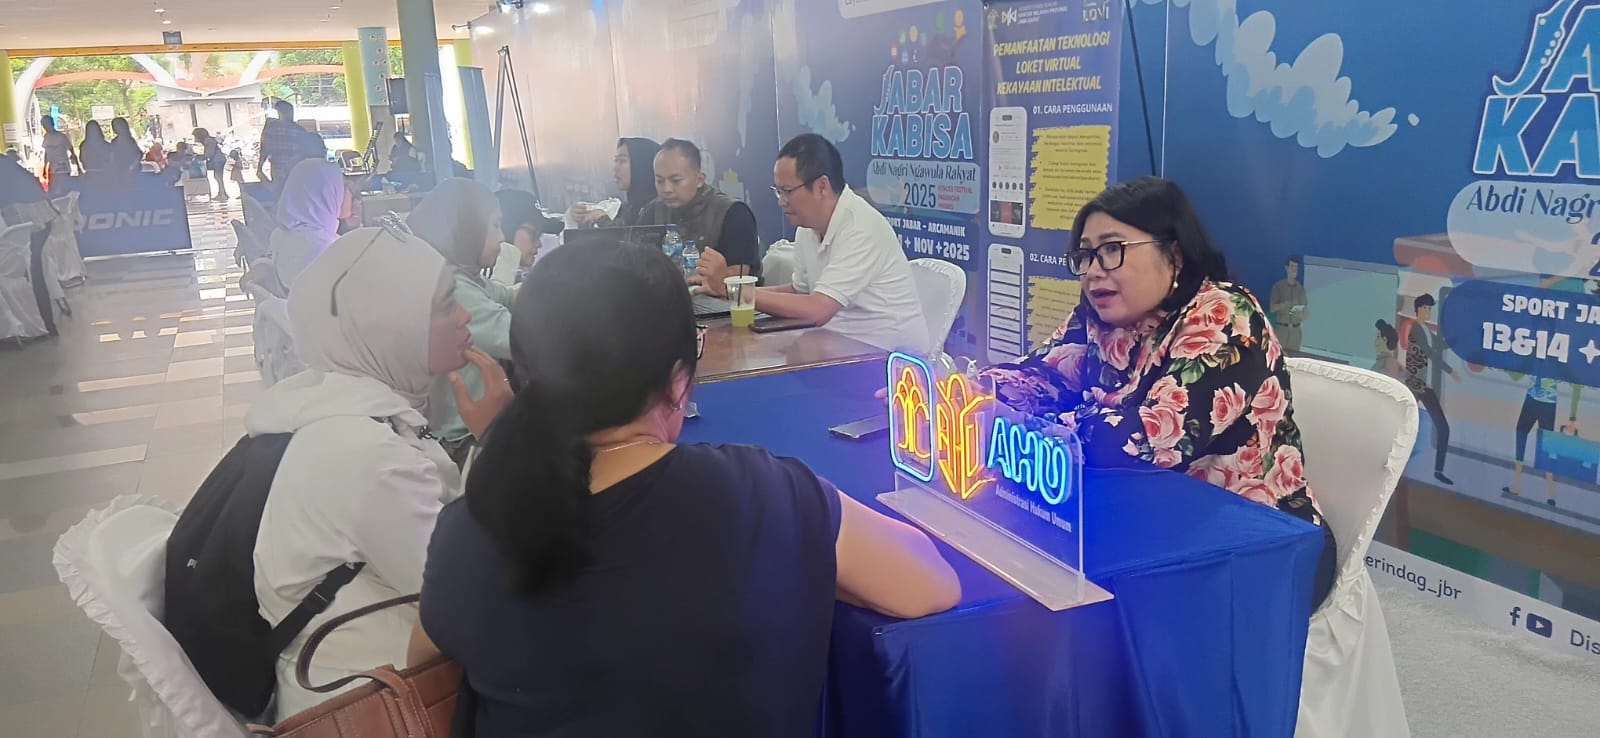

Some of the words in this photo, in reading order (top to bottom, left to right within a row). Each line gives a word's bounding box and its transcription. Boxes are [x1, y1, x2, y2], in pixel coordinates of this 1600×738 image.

[993, 37, 1056, 57] PEMANFAATAN
[1057, 31, 1111, 50] TEKNOLOGI
[1015, 59, 1044, 75] LOKET
[1044, 55, 1081, 72] VIRTUAL
[873, 64, 963, 116] JABAR
[996, 80, 1041, 96] KEKAYAAN
[1042, 75, 1102, 92] INTELEKTUAL
[1032, 106, 1043, 115] 01.
[1043, 104, 1062, 115] CARA
[1062, 102, 1113, 114] PENGGUNAAN
[871, 112, 973, 160] KABISA
[945, 164, 977, 184] Rakyat
[903, 182, 937, 209] 2025
[1466, 185, 1526, 212] Abdi
[914, 236, 934, 256] NOV
[943, 240, 970, 262] 2025
[1029, 252, 1040, 263] 02.
[1040, 254, 1058, 266] CARA
[1502, 293, 1569, 321] SPORT
[1481, 321, 1570, 364] 13&14
[987, 417, 1069, 504] AHU
[1030, 499, 1052, 523] Hukum
[1051, 511, 1073, 534] Umum
